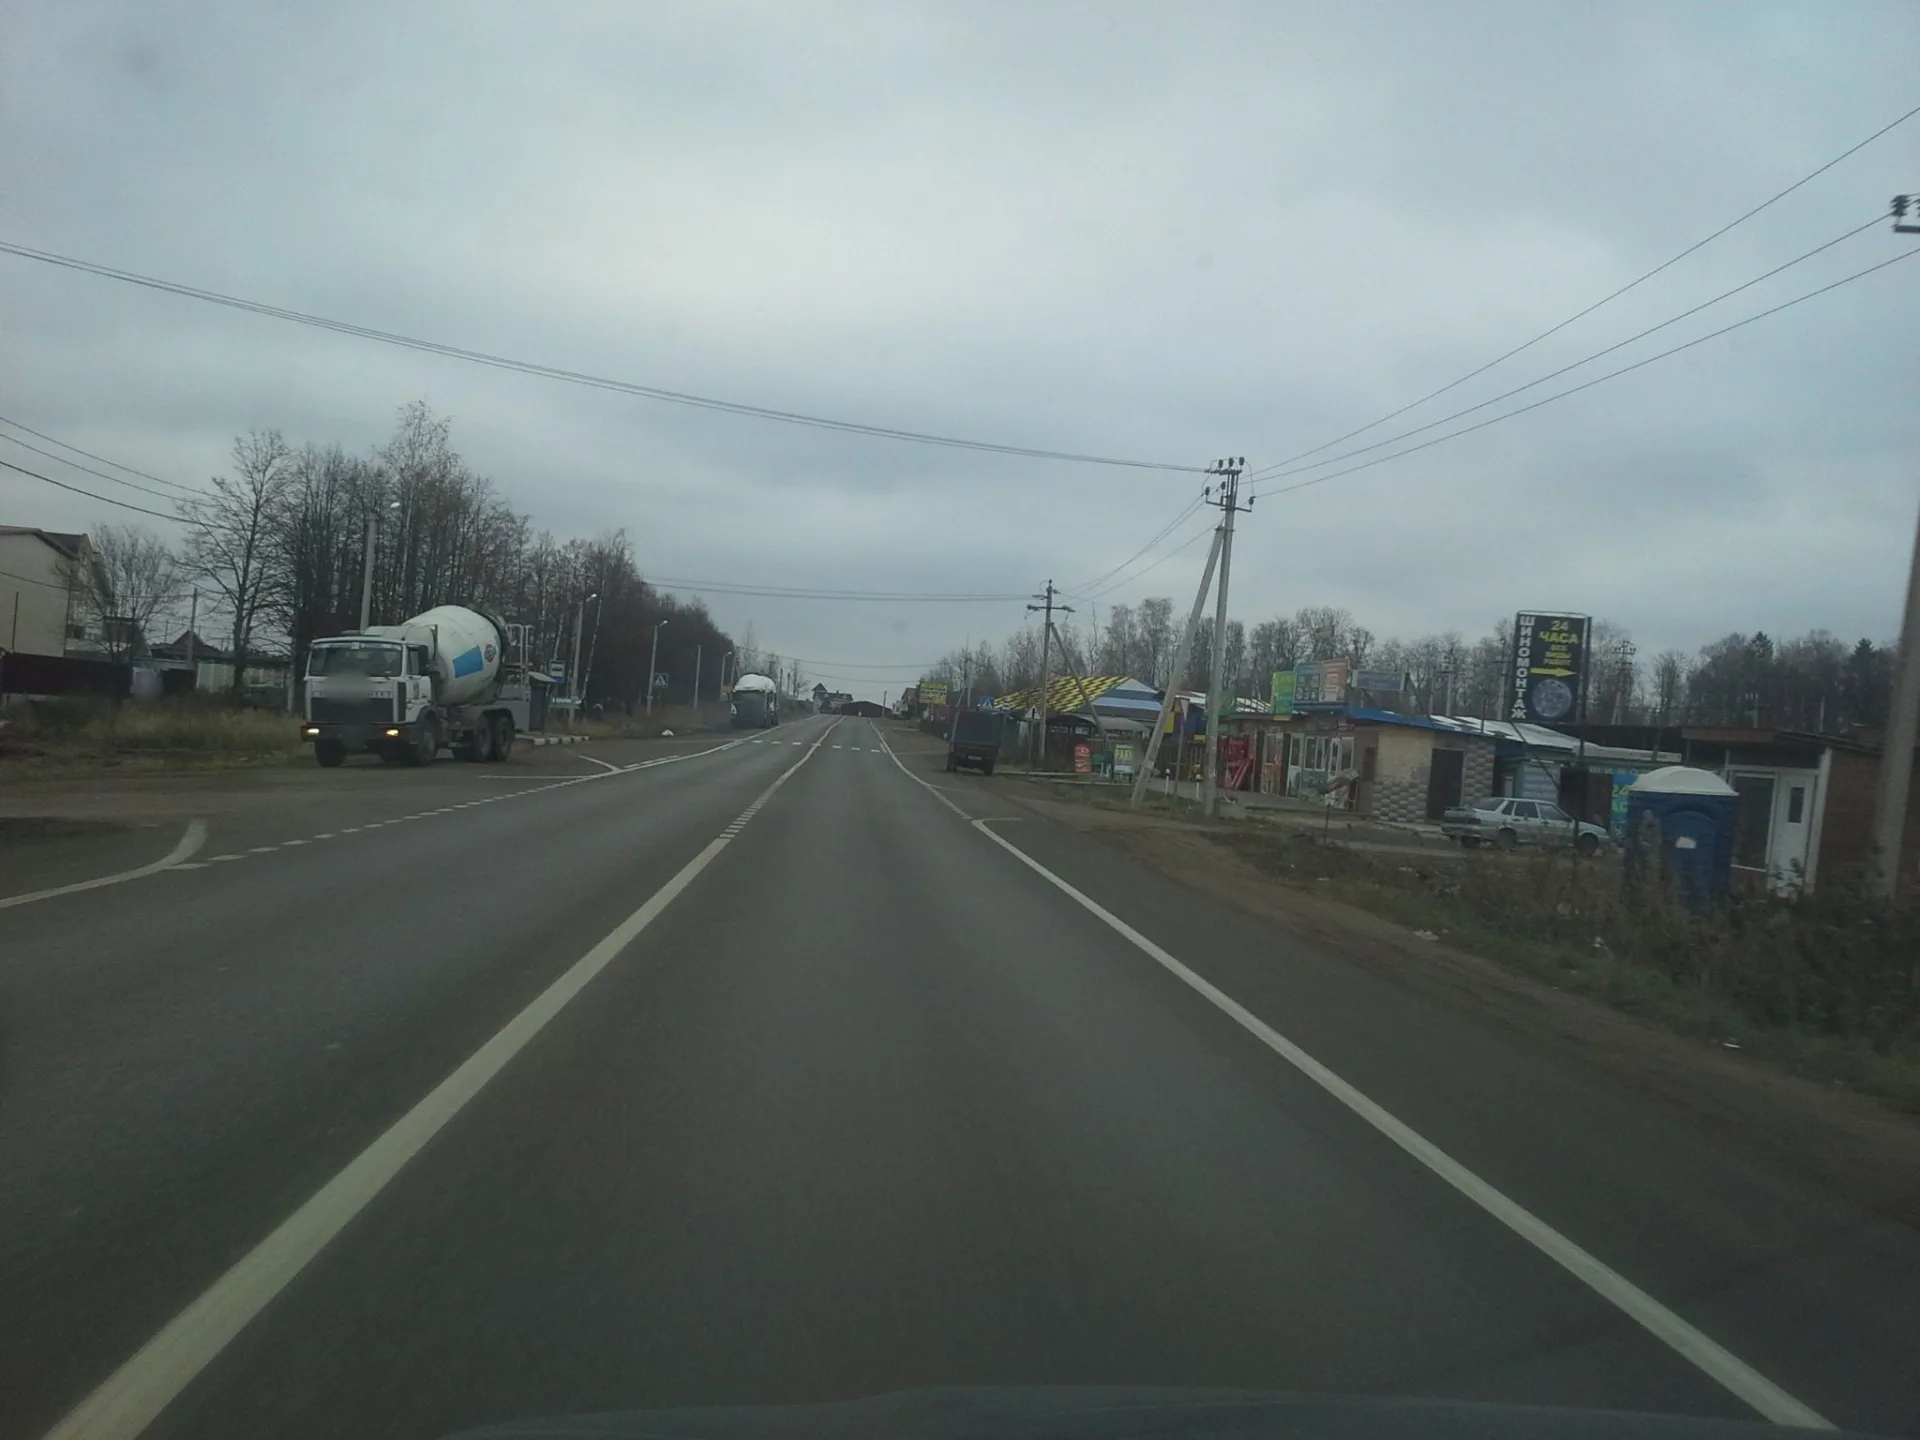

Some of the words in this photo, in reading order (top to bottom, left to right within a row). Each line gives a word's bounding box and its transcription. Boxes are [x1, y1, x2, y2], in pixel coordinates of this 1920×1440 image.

[1551, 620, 1569, 631] 24
[1539, 631, 1580, 644] ЧАСА
[1511, 616, 1536, 719] ШИНОМОНТАЖ
